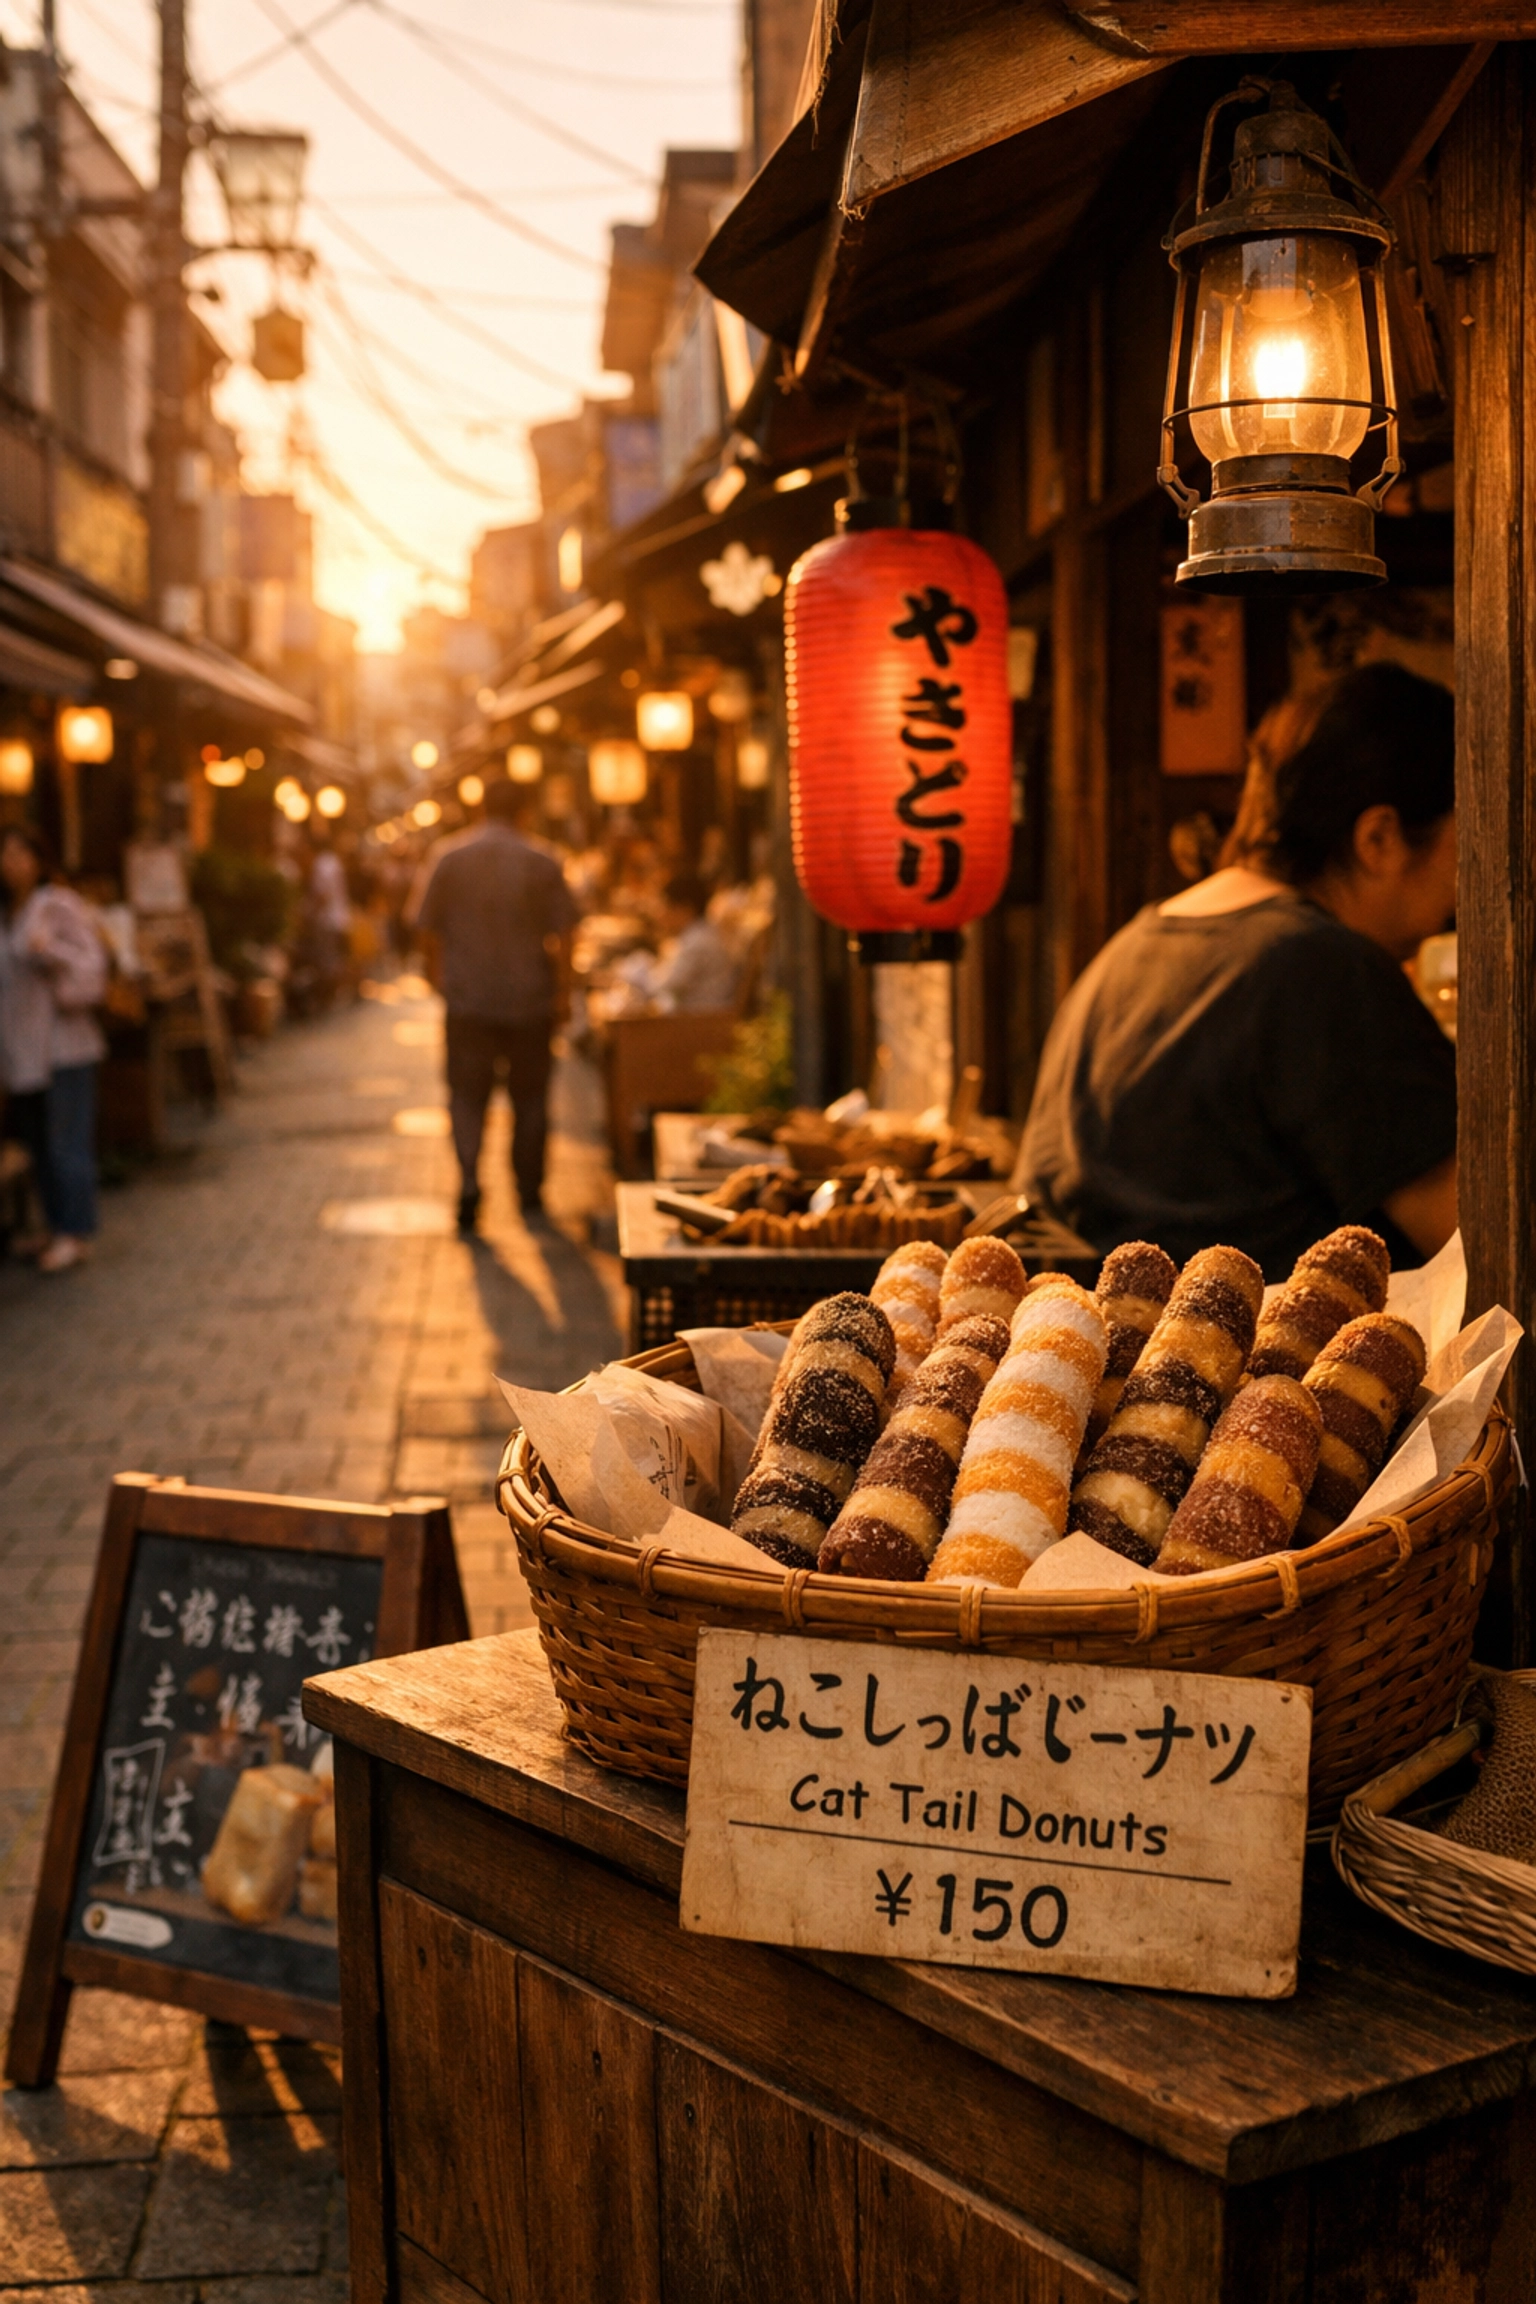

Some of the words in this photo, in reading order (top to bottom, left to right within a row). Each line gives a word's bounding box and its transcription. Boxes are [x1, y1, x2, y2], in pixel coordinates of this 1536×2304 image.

[891, 585, 980, 904] やきとり
[790, 1773, 870, 1820] Cat
[889, 1782, 978, 1833] Tail
[998, 1792, 1168, 1857] Donuts
[874, 1867, 1069, 1950] ¥150
